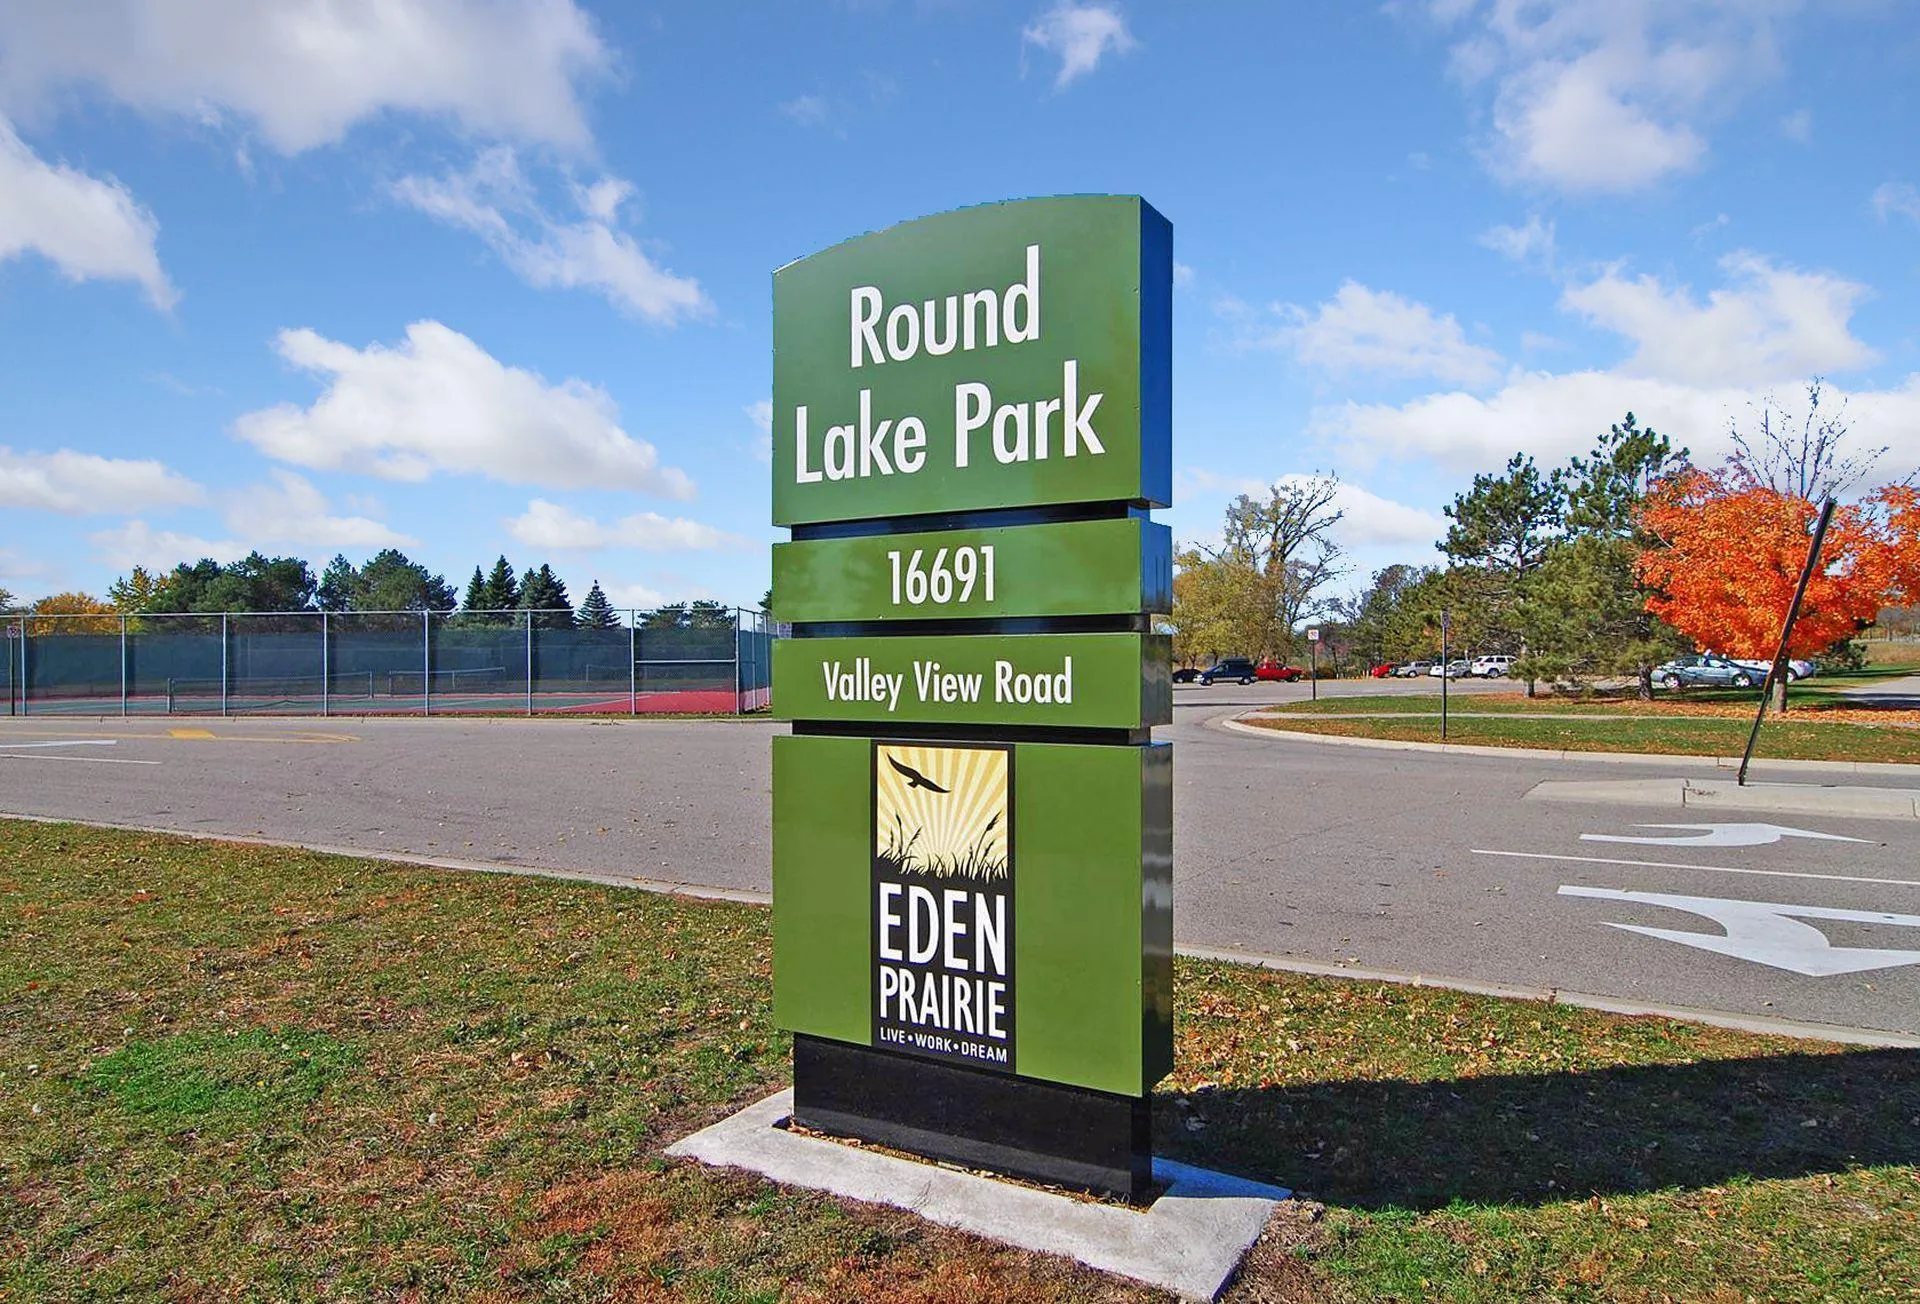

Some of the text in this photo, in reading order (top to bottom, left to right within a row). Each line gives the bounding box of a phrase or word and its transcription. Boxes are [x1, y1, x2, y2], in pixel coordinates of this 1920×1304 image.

[852, 245, 1039, 367] Round
[796, 360, 1105, 483] Lake Park
[889, 546, 993, 604] 16691
[823, 657, 1071, 711] Valley View Road
[879, 880, 1006, 977] EDEN
[880, 966, 1007, 1038] PRAIRIE
[880, 1026, 1007, 1062] LIVE WORK DREAM
